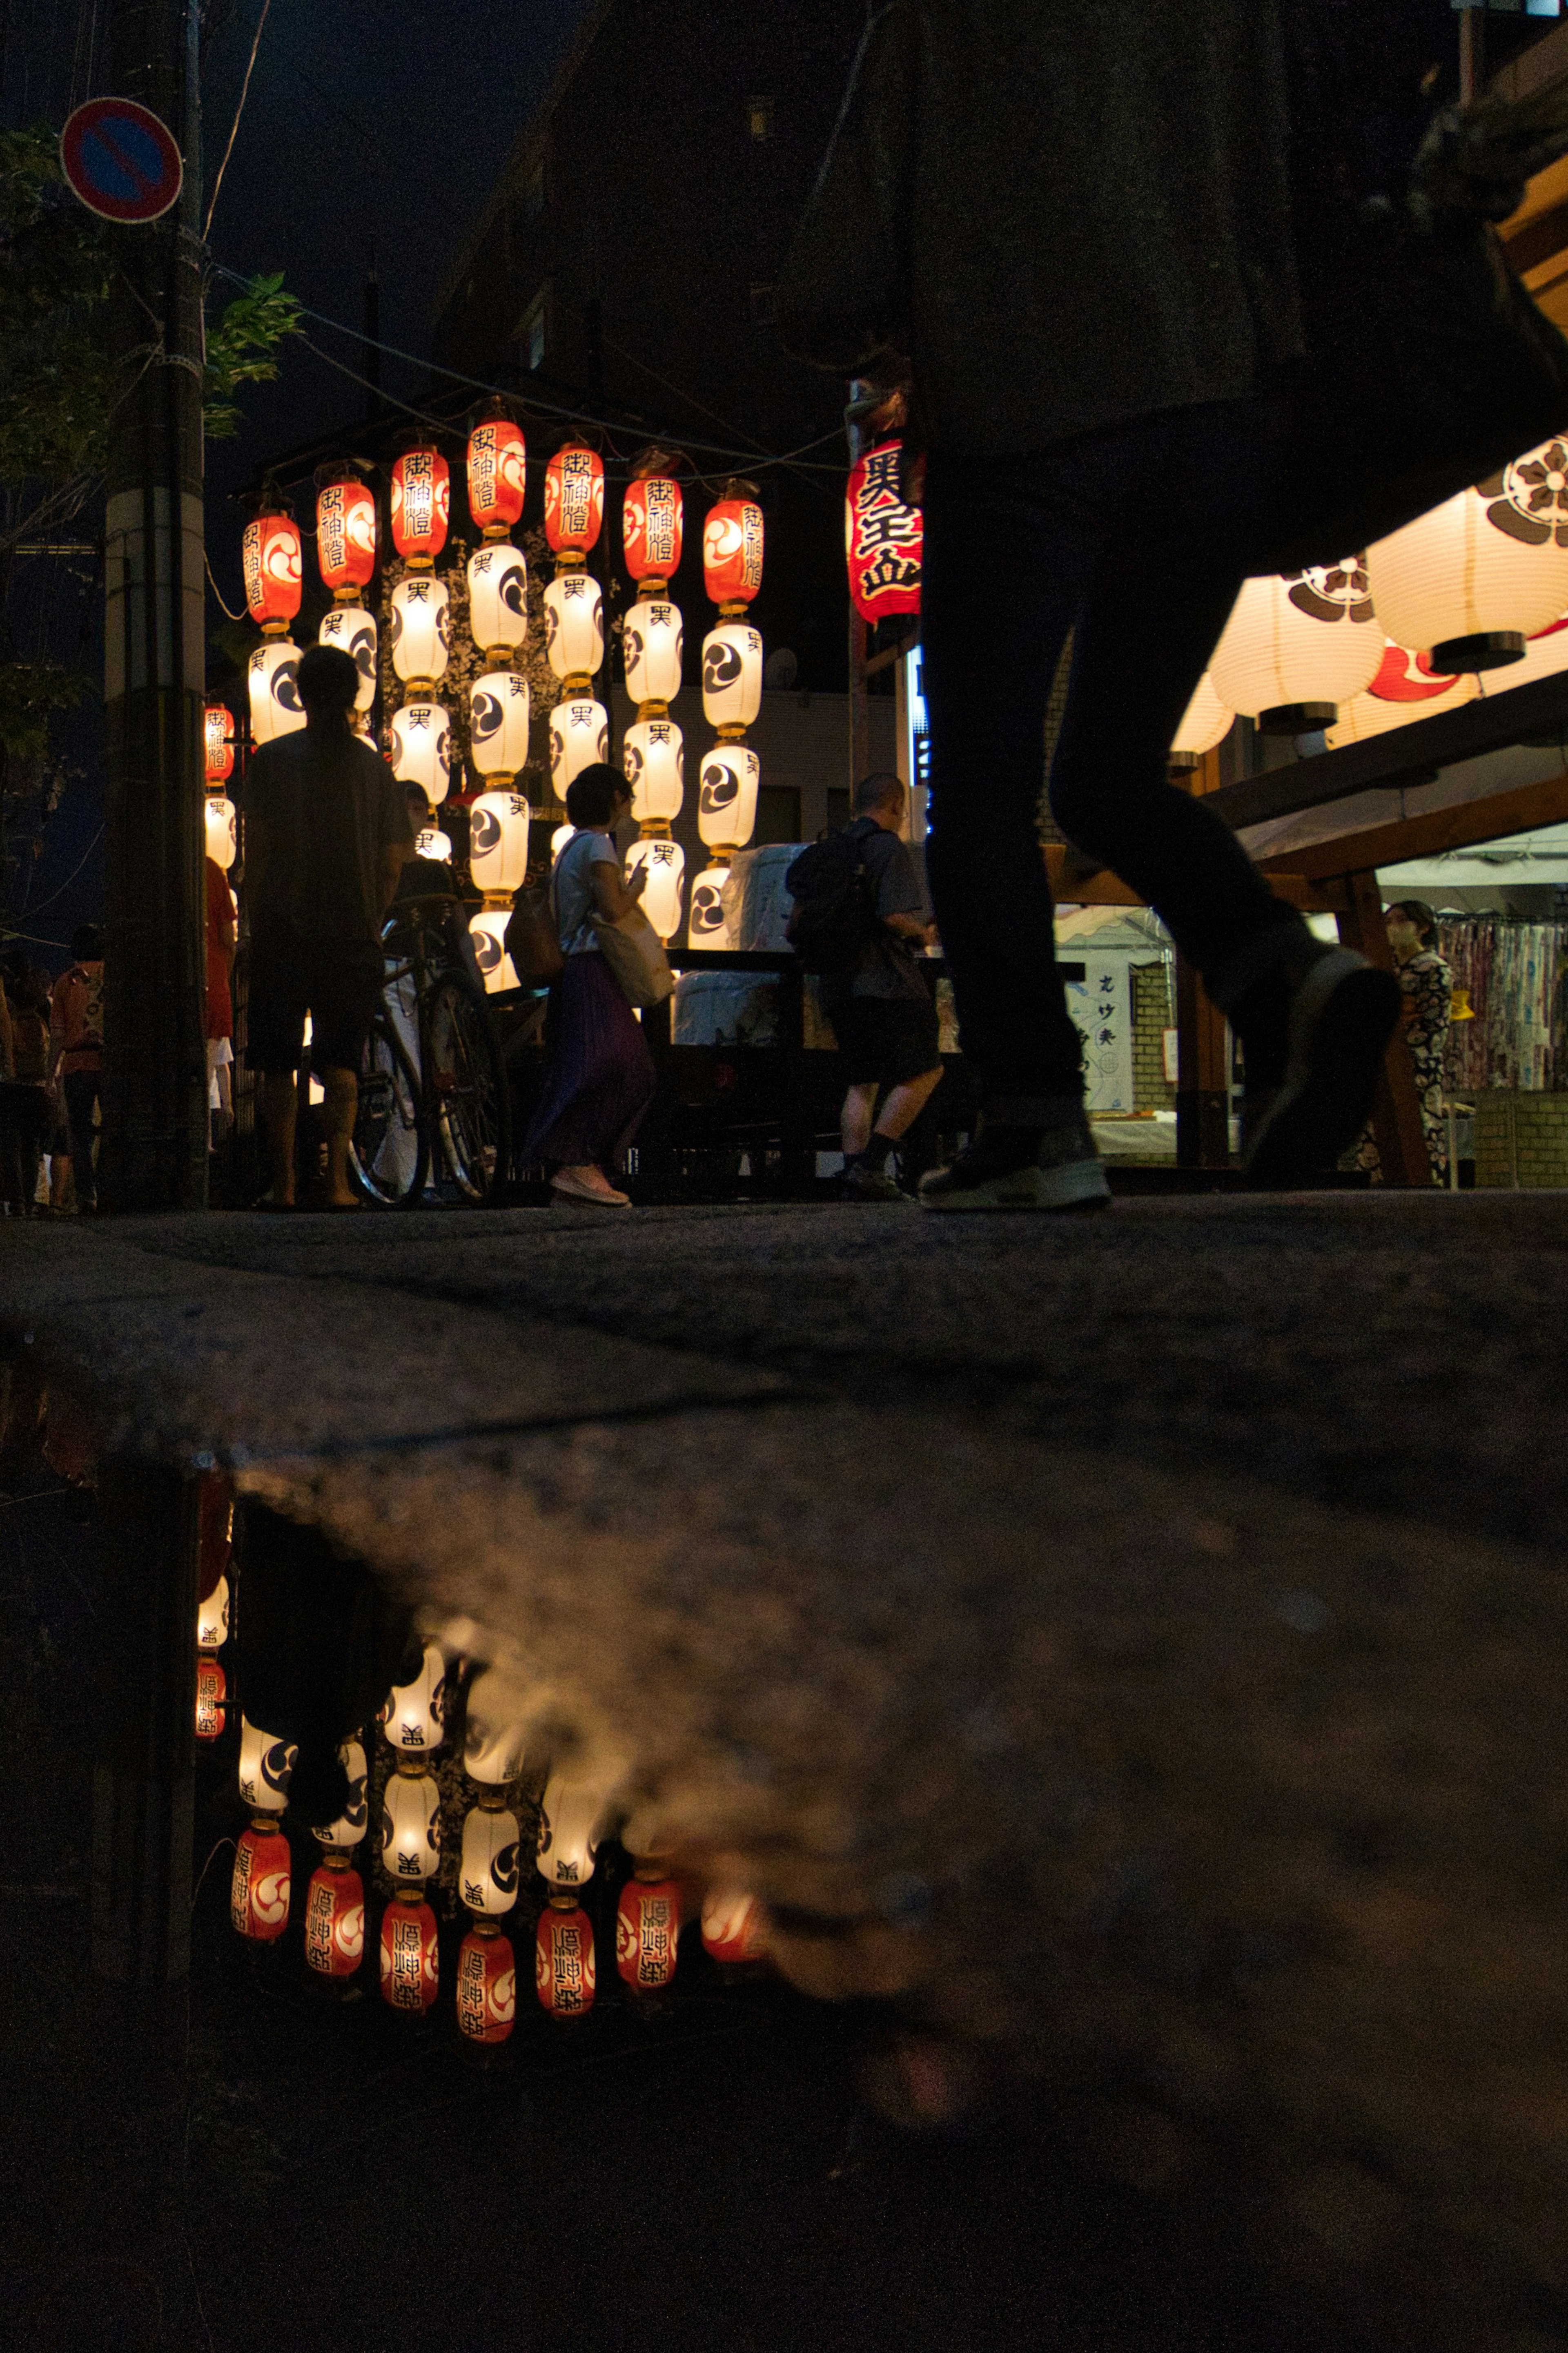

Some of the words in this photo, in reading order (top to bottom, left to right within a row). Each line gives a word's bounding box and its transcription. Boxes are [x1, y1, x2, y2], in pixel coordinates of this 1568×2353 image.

[404, 453, 432, 538] 御神燈
[562, 453, 590, 534] 御神燈
[646, 482, 674, 563] 御神燈
